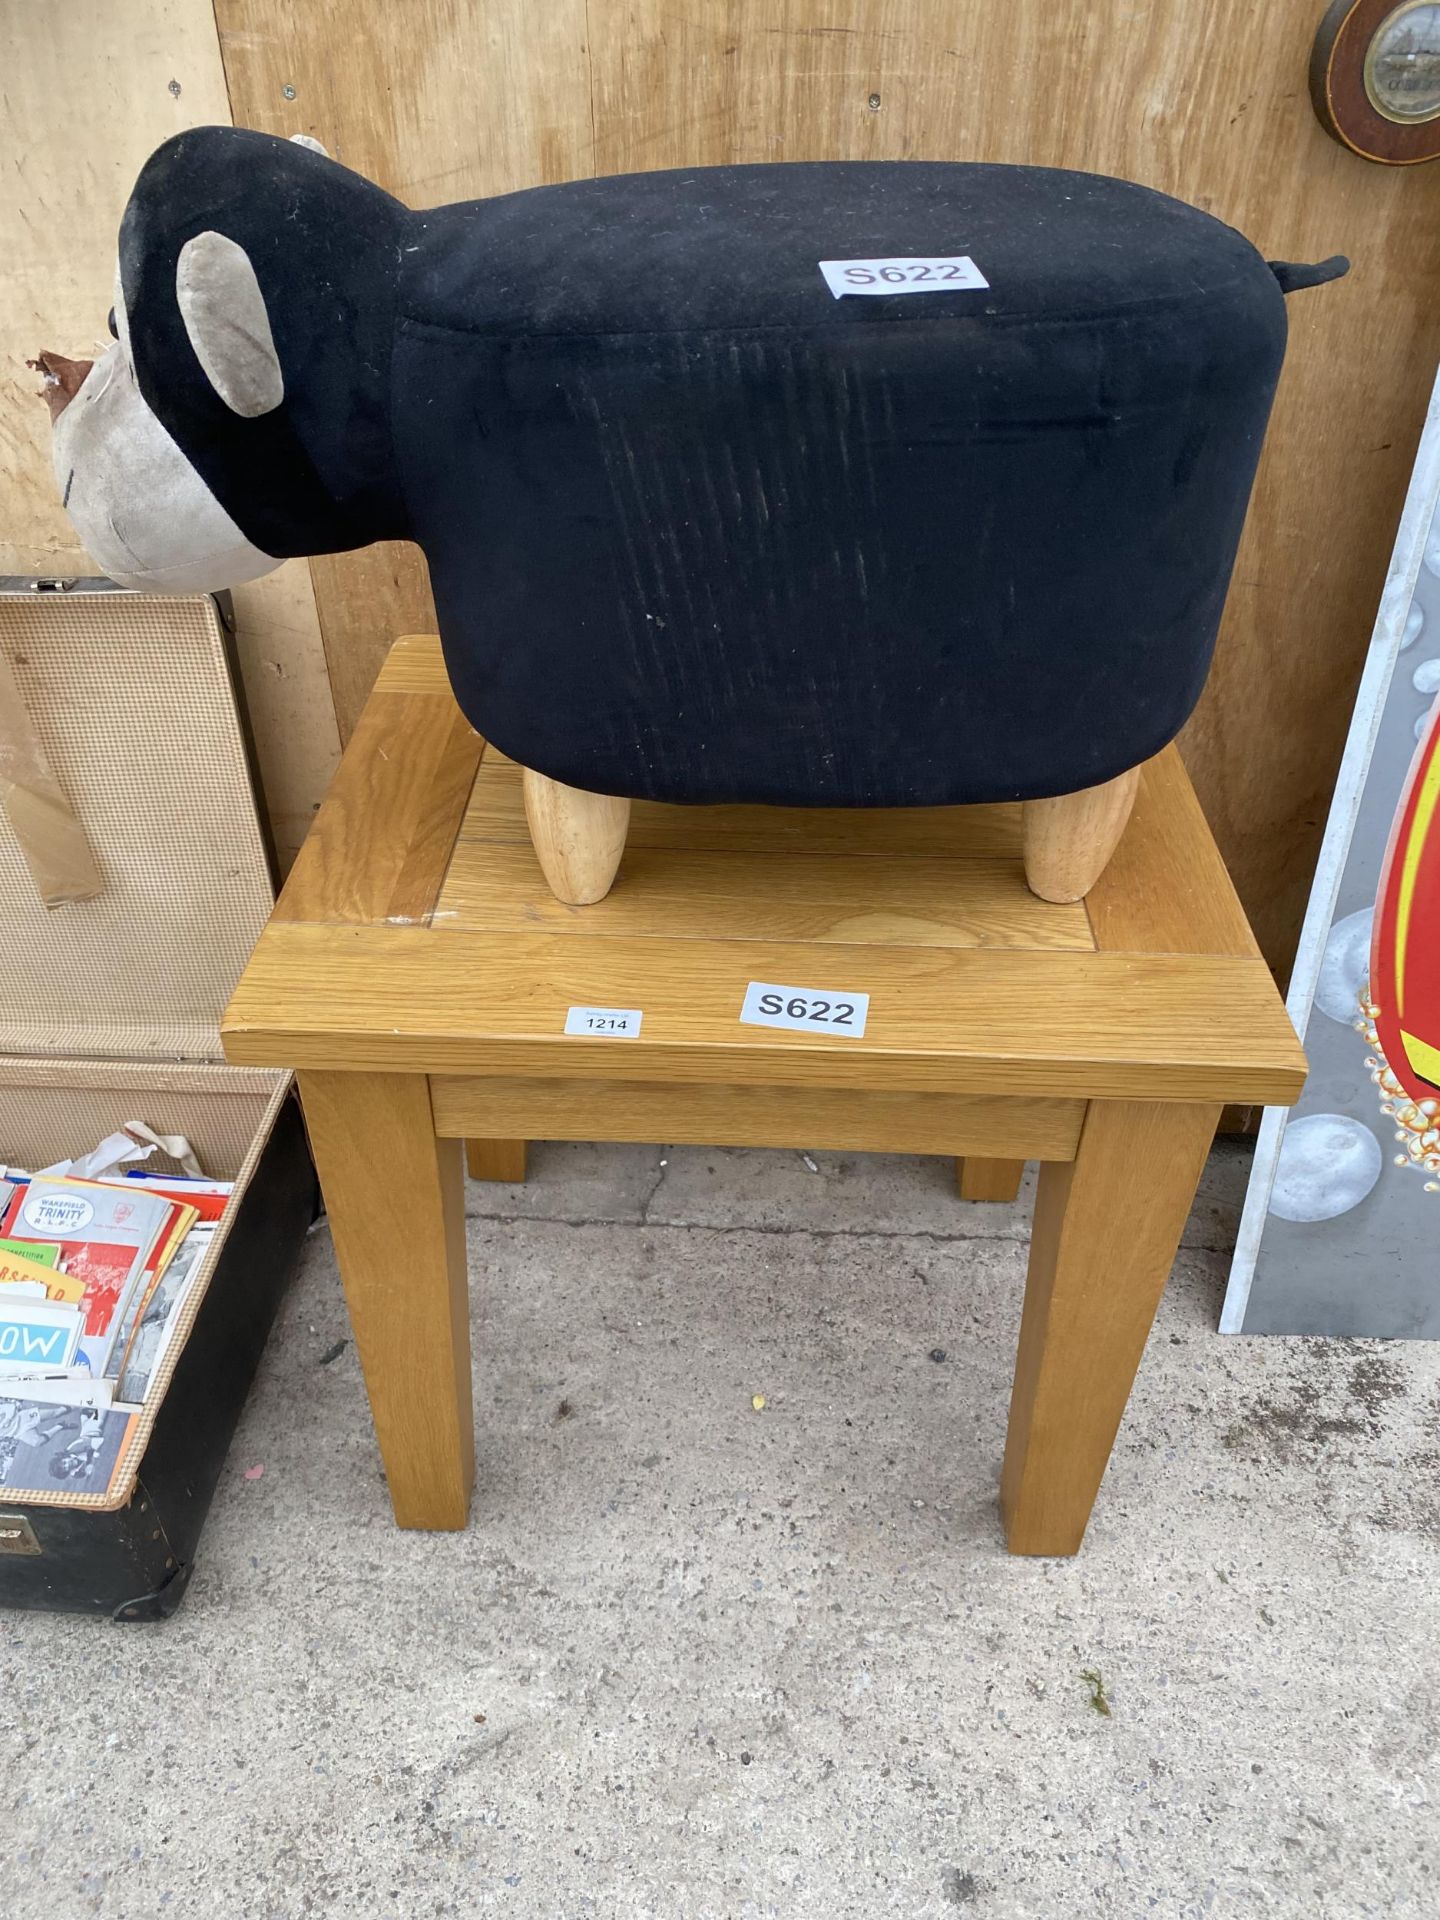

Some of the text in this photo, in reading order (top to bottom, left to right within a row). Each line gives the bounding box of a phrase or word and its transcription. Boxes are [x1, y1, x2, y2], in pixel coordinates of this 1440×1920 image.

[844, 265, 969, 285] S622
[758, 993, 855, 1025] S622
[587, 1018, 627, 1029] 1214
[41, 1199, 86, 1209] WAKEFIELD
[39, 1206, 85, 1220] TRINITY
